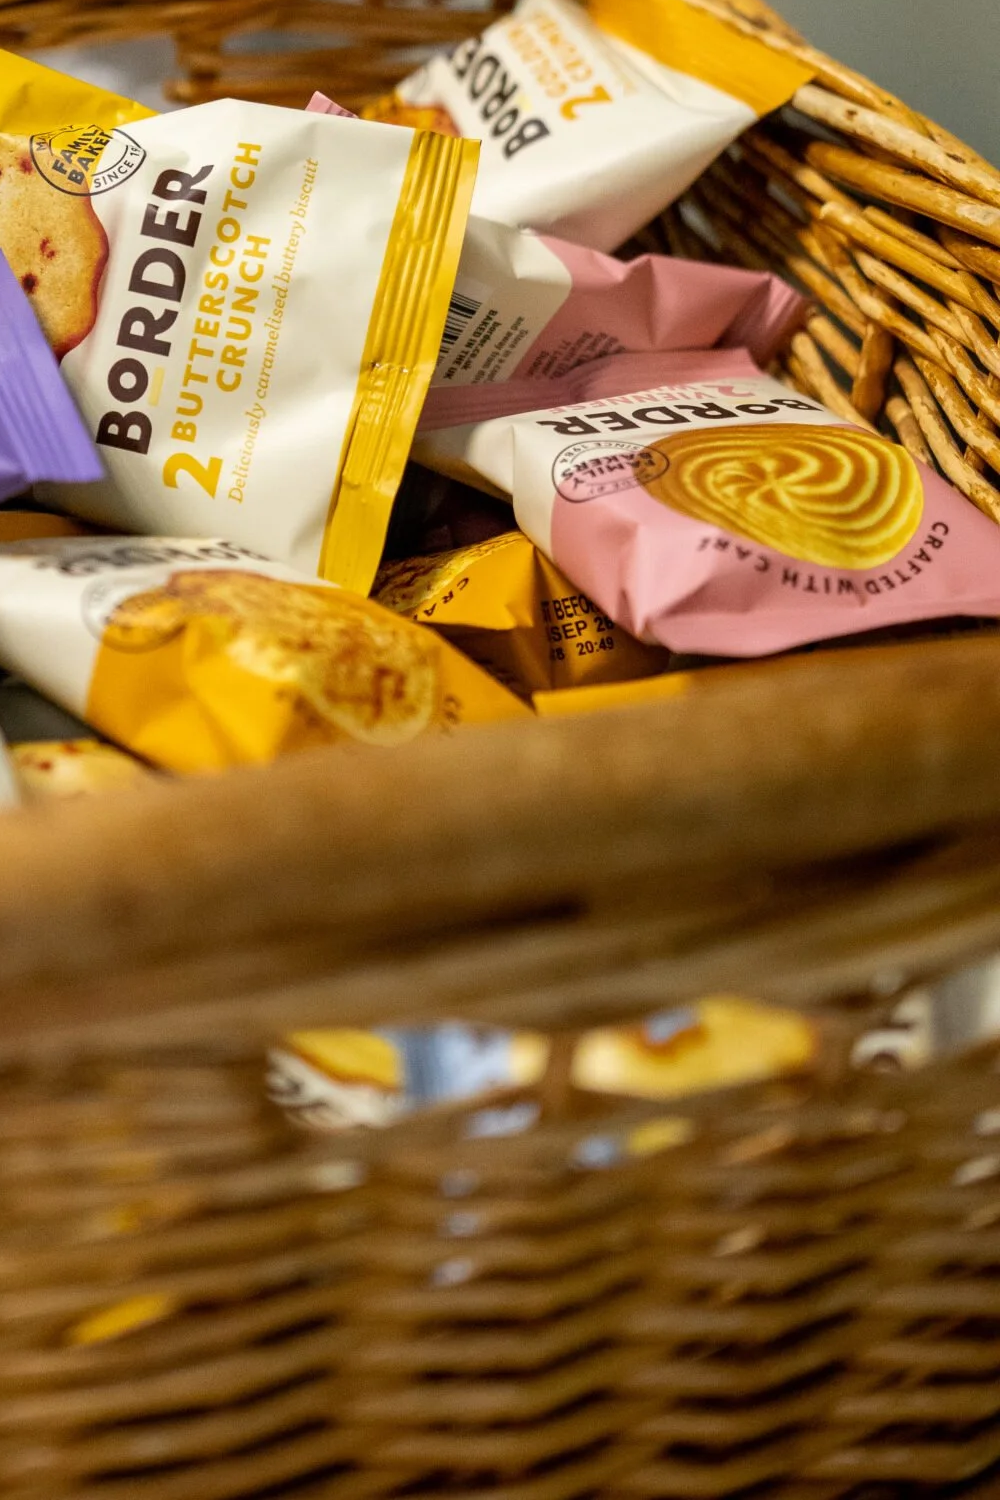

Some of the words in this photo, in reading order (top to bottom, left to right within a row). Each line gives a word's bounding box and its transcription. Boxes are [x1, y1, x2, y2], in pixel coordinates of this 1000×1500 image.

[452, 37, 552, 161] BORDE
[559, 83, 614, 122] 2
[51, 128, 100, 176] FAMIL
[67, 130, 114, 186] BAKE
[93, 158, 135, 189] SINCE
[95, 163, 215, 456] BORDER
[170, 141, 263, 444] BUTTERSCOTCH
[215, 234, 272, 393] CRUNCH
[227, 402, 268, 504] Deliciously
[256, 284, 291, 399] caramelised
[277, 220, 308, 285] buttery
[293, 157, 320, 221] biscuit
[473, 308, 499, 339] BAKED
[452, 350, 470, 366] THE
[464, 338, 478, 350] IN
[443, 366, 458, 381] UK
[536, 398, 824, 437] BORDER
[162, 451, 224, 500] 2
[560, 451, 654, 482] BAKERS
[571, 457, 657, 490] FAMILY
[864, 520, 950, 596] CRAFTED
[781, 566, 856, 596] WITH
[550, 620, 588, 643] SEP
[575, 636, 615, 657] 20:49
